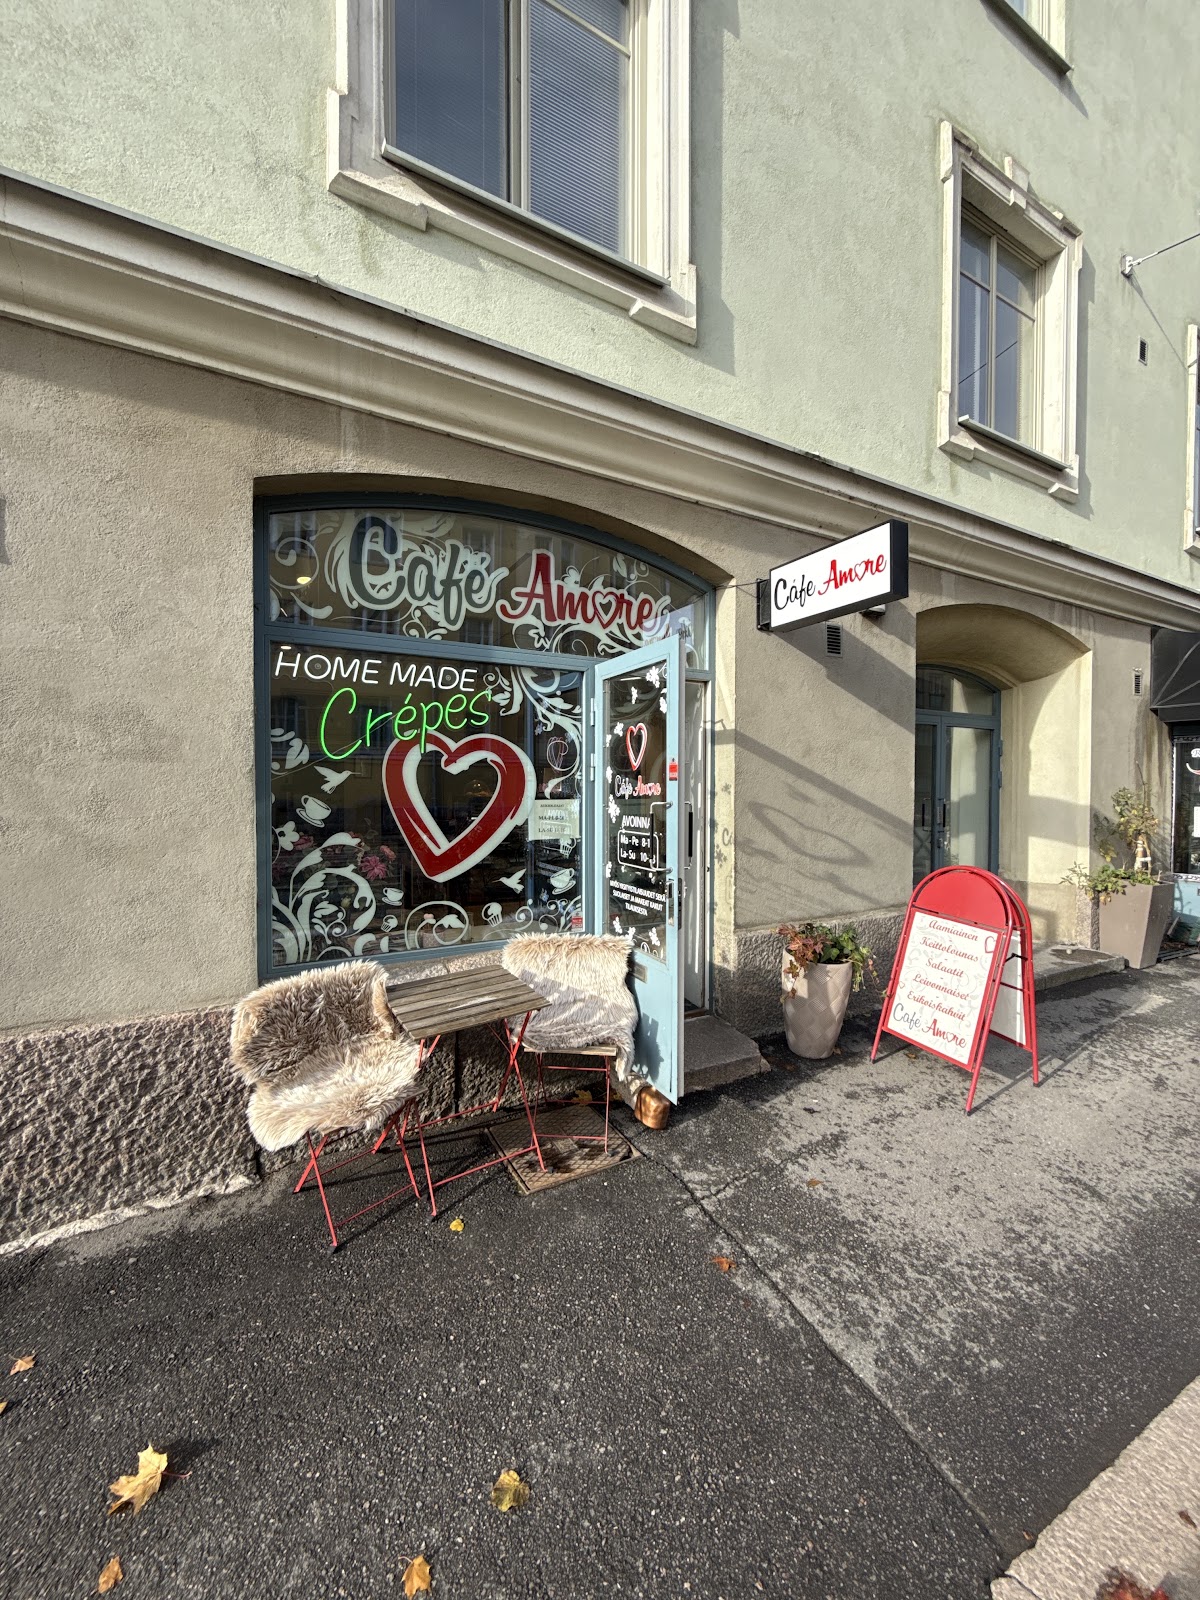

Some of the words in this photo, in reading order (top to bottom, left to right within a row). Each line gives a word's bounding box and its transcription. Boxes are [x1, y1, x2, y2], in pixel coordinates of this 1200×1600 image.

[817, 554, 888, 596] Amore
[498, 551, 667, 630] Amore
[274, 651, 382, 684] HOME
[389, 661, 478, 693] MADE
[928, 919, 979, 942] Aamiainen
[919, 936, 979, 963] Keittolounas
[925, 958, 964, 978] Salaatit
[912, 973, 970, 1001] Leivonnaiset
[906, 991, 966, 1022] Erikoiskahvit
[921, 1018, 968, 1048] Amore
